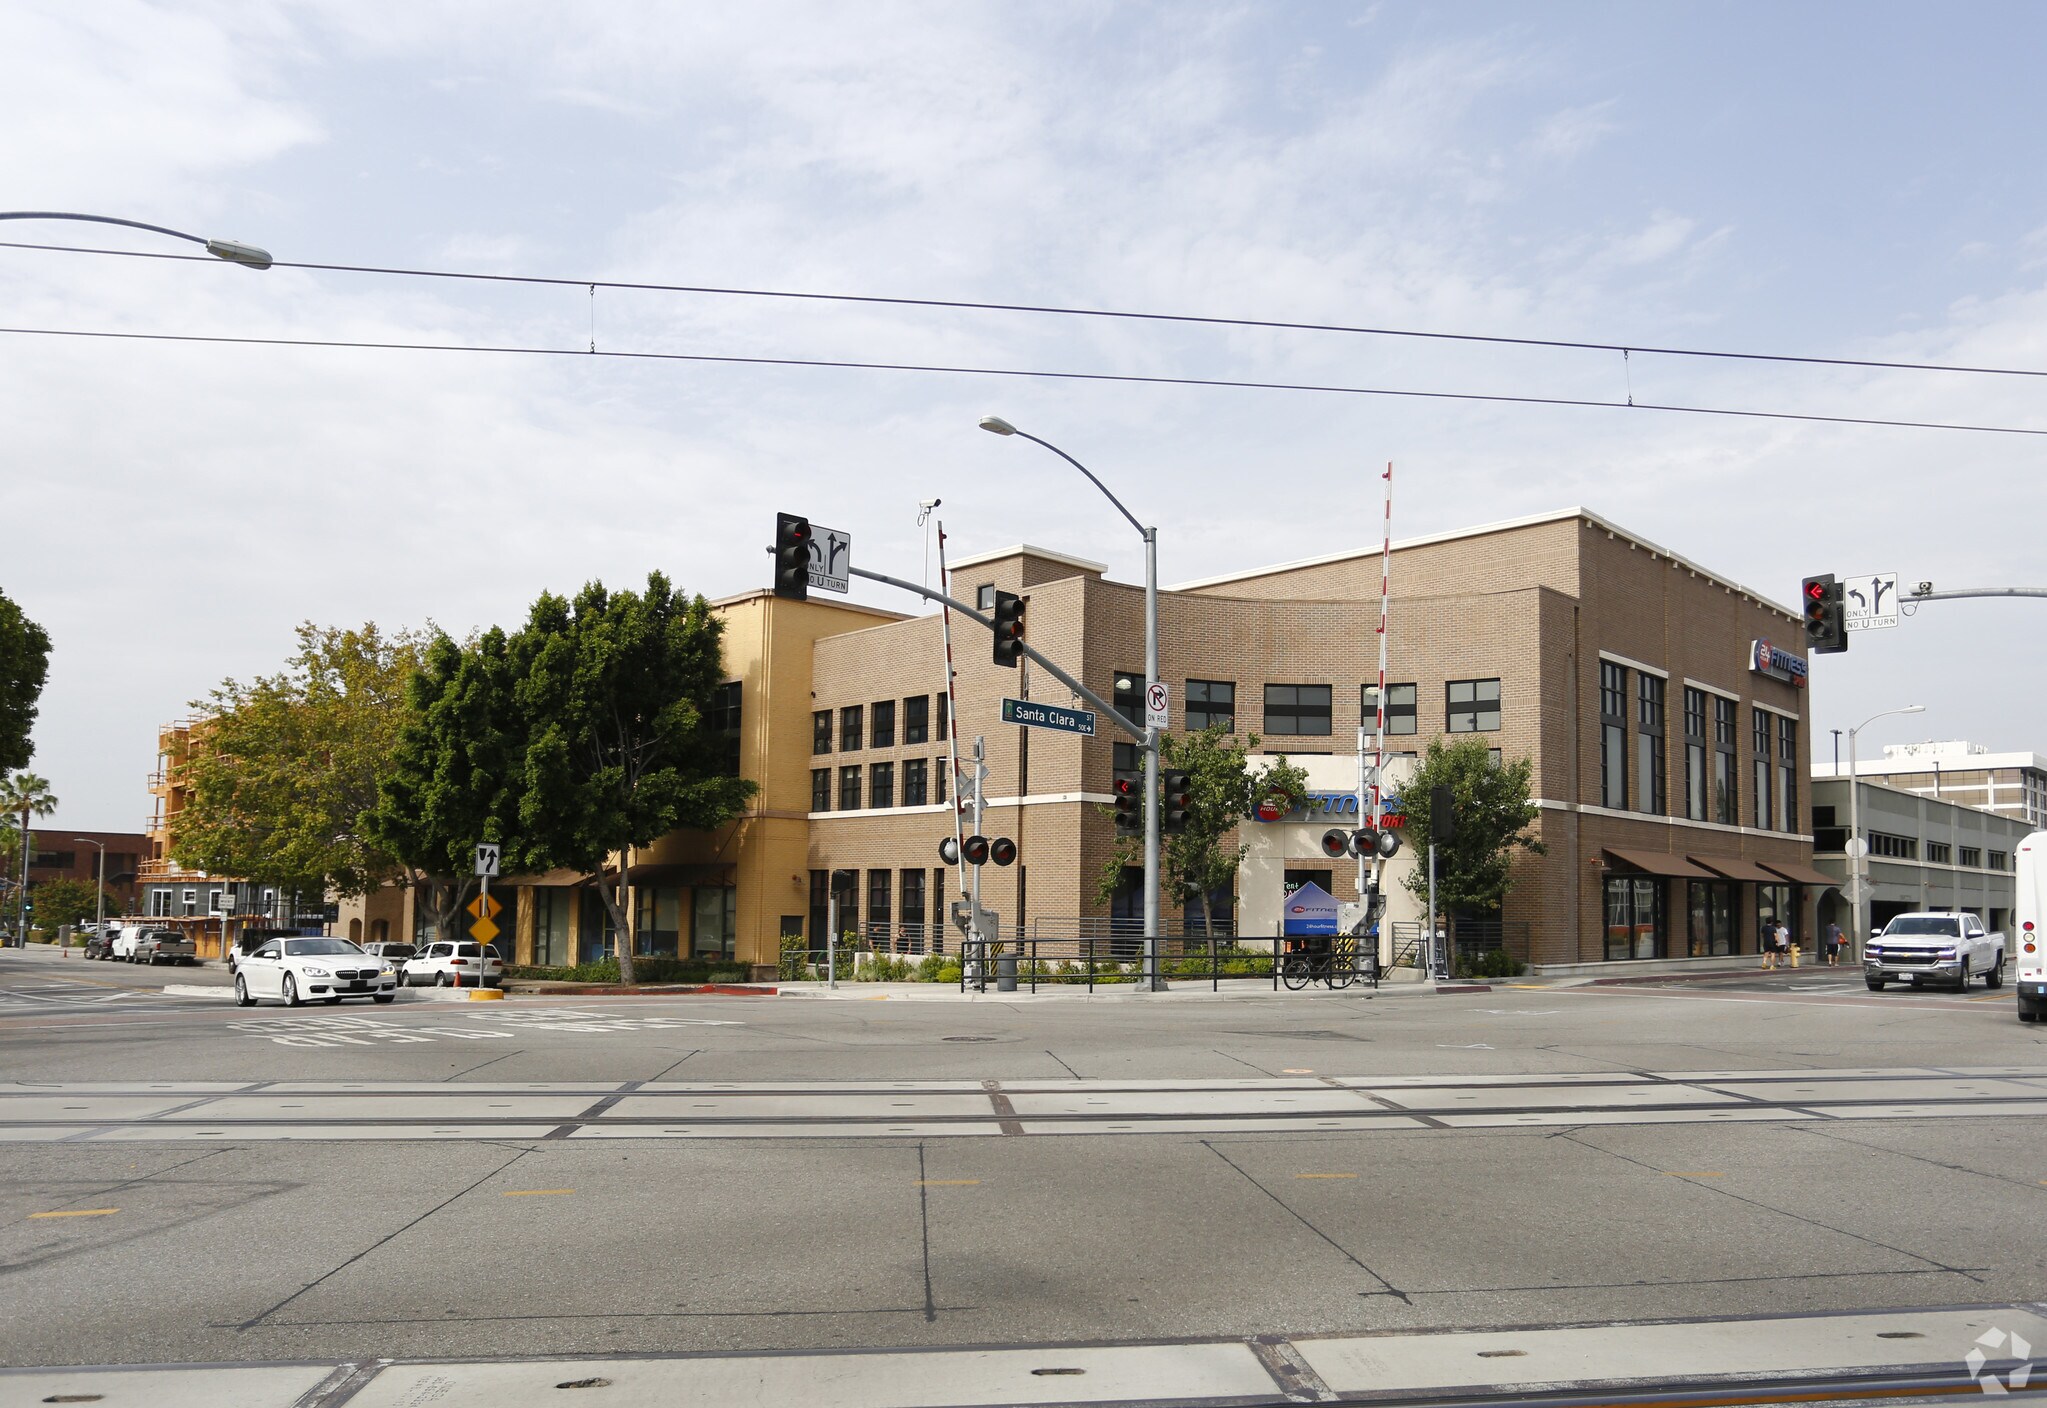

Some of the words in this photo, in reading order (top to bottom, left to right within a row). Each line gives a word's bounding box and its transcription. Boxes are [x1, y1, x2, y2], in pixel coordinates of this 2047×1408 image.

[809, 563, 824, 572] NLY
[817, 576, 824, 587] U
[826, 579, 846, 590] TURN
[1846, 609, 1868, 618] ONLY
[1847, 621, 1859, 629] NO
[1862, 619, 1870, 628] U
[1873, 617, 1896, 626] TURN
[1016, 706, 1045, 722] Santa
[1049, 711, 1075, 727] Clara
[1147, 713, 1155, 722] ON
[1157, 714, 1167, 723] RED
[1365, 814, 1406, 828] SORT
